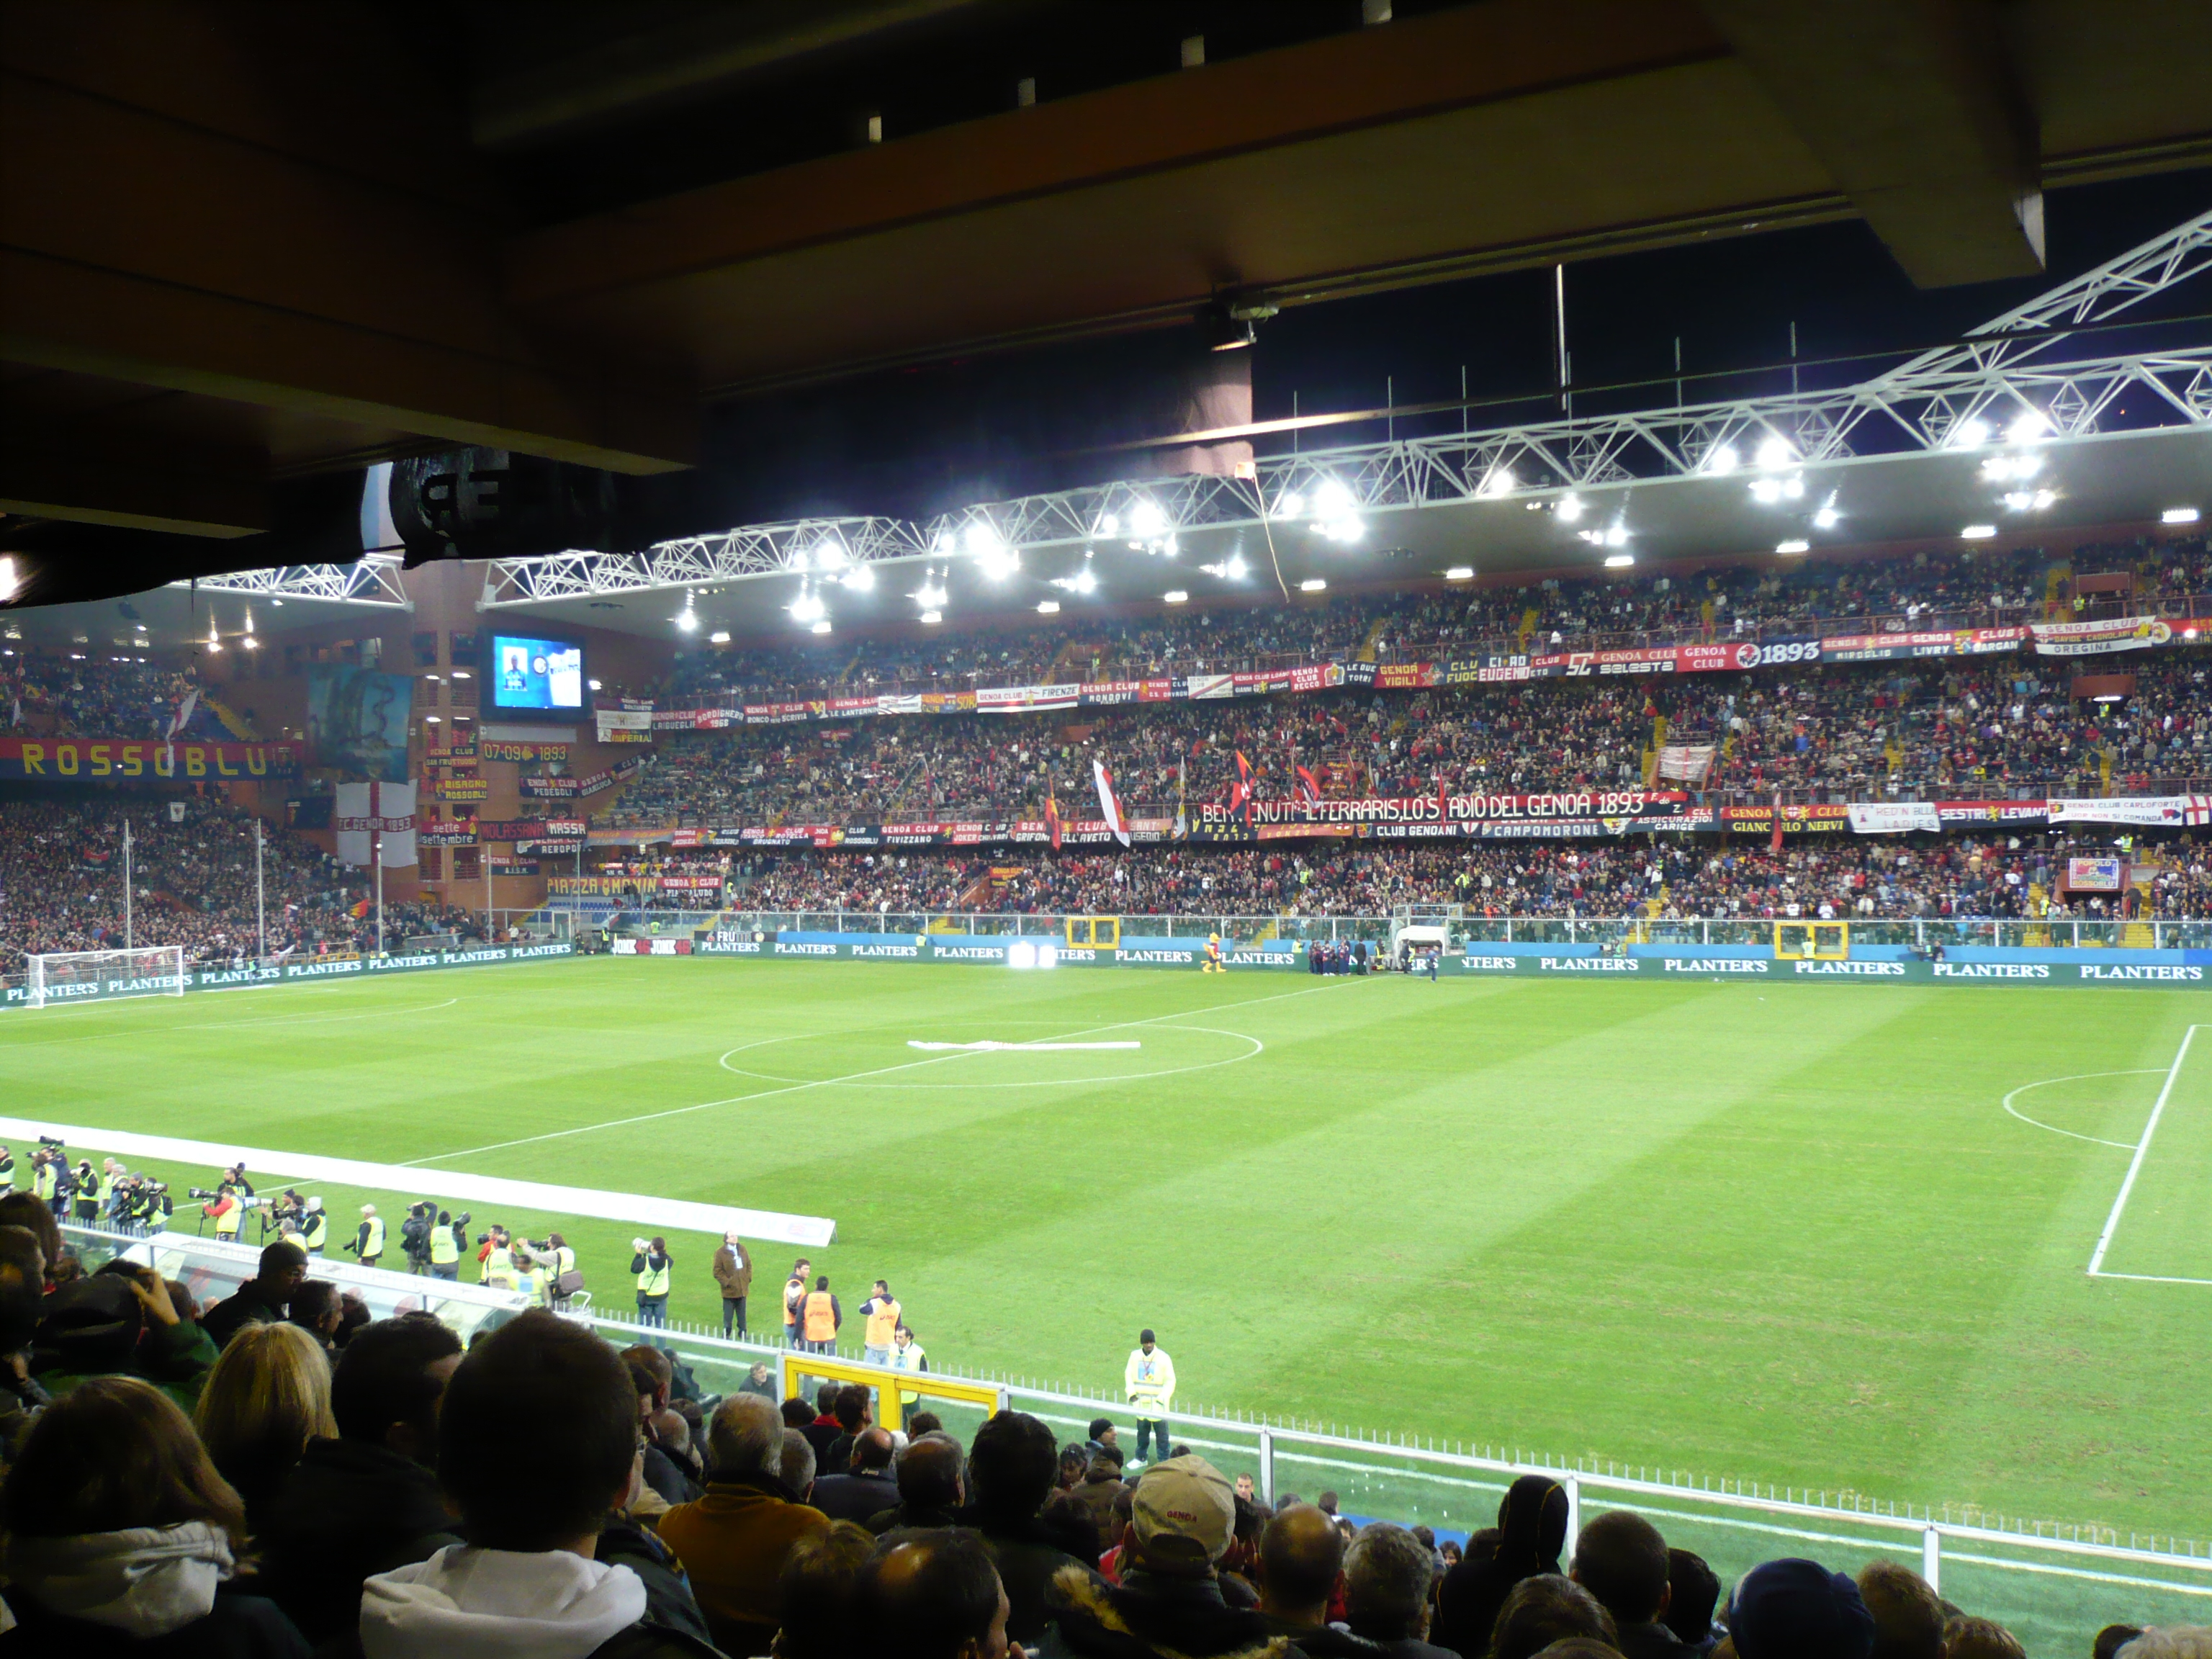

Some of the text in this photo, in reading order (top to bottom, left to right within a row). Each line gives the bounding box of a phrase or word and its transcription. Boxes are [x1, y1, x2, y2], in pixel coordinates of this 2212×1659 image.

[2046, 618, 2139, 634] GENOA CLUB
[1912, 628, 2015, 643] GENOA CLUB
[1684, 647, 1727, 657] GENOA
[1761, 639, 1821, 664] 1893
[1912, 645, 1950, 656] LIVRY
[2054, 642, 2112, 654] OREGINA
[1535, 656, 1560, 666] CLUB
[1601, 652, 1642, 662] GENOA
[1346, 663, 1377, 673] LE DUE
[1380, 664, 1419, 675] GENOA
[1693, 659, 1725, 669] CLUB
[1292, 667, 1319, 676] GENOA
[1446, 670, 1478, 684] FUOC
[1297, 674, 1318, 683] CLUB
[1384, 675, 1417, 687] VIGILI
[1082, 682, 1140, 693] GENOA CLUB
[1294, 681, 1320, 691] RECCO
[979, 693, 1002, 701] GENOA
[1042, 686, 1078, 698] FIRENZE
[747, 703, 804, 714] GENOA CLUB
[841, 706, 878, 717] LANTERNIN
[747, 715, 770, 724] RONCO
[539, 745, 567, 762] 1893
[22, 743, 268, 777] ROSSOBLU
[444, 780, 487, 788] BISAGNO
[1426, 796, 1486, 820] SADIO
[1490, 796, 1524, 818] DEL
[1527, 793, 1591, 817] GENOA
[1596, 792, 1645, 815] 1893
[1730, 808, 1773, 818] GENOA
[1940, 806, 2049, 820] SESTRI LEVANT
[2123, 814, 2162, 822] COMANDA
[352, 817, 384, 831] GENOA
[387, 817, 411, 831] 1893
[433, 822, 460, 833] sette
[548, 822, 587, 835] MASSA
[881, 824, 940, 834] GENOA CLUB
[1076, 822, 1107, 831] CLUB
[1732, 820, 1844, 832] GIANCRLO NERVI
[1884, 819, 1935, 828] LADIES
[1376, 824, 1457, 836] CLUB GENOANI
[1493, 824, 1599, 837] CAMPOMORONE
[422, 833, 474, 845] settembre
[886, 835, 932, 844] FIVIZZANO
[953, 833, 977, 842] JOKER
[1061, 832, 1111, 843] ELL'AVETO
[547, 878, 598, 894] PIAZZA
[664, 878, 719, 886] GENOA CLUB
[511, 943, 572, 958] PLANTER'S
[701, 940, 760, 953] PLANTER'S
[775, 943, 837, 956] PLANTER'S
[852, 944, 918, 957] PLANTER'S
[443, 948, 507, 964] PLANTER'S
[934, 947, 1004, 959] PLANTER'S
[1115, 950, 1193, 963] PLANTER'S
[287, 960, 362, 977] PLANTER'S
[369, 954, 437, 971] PLANTER'S
[1540, 958, 1639, 971] PLANTER'S
[1664, 958, 1768, 972] PLANTER'S
[1794, 961, 1905, 976] PLANTER'S
[202, 966, 281, 986] PLANTR'S
[1933, 963, 2050, 978] PLANTER'S
[2080, 965, 2203, 980] PLANTER'S
[108, 974, 193, 993] PLANTER'S
[1166, 1509, 1197, 1523] GENOA
